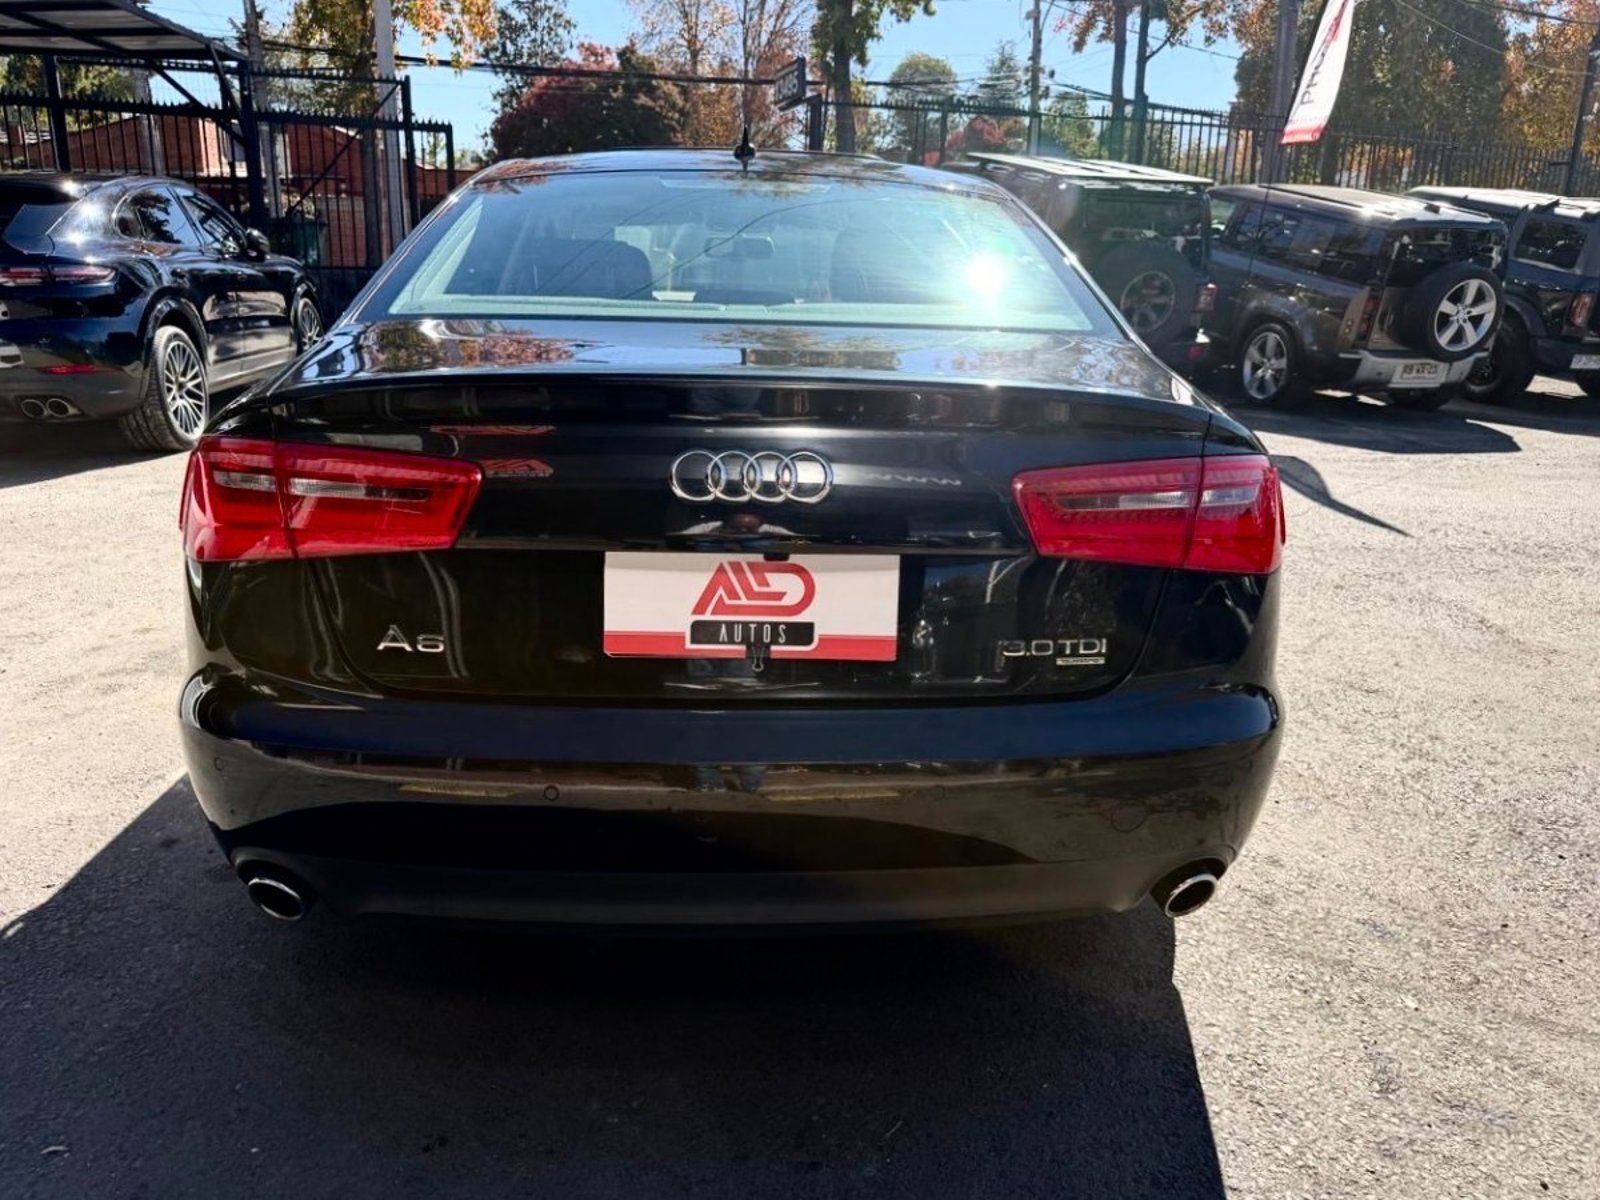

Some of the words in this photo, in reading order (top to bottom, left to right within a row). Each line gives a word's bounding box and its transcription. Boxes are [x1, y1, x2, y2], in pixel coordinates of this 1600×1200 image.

[376, 624, 445, 653] A6
[719, 622, 788, 644] AUTOS
[1002, 639, 1053, 656] 3.0
[1058, 638, 1107, 655] TDI
